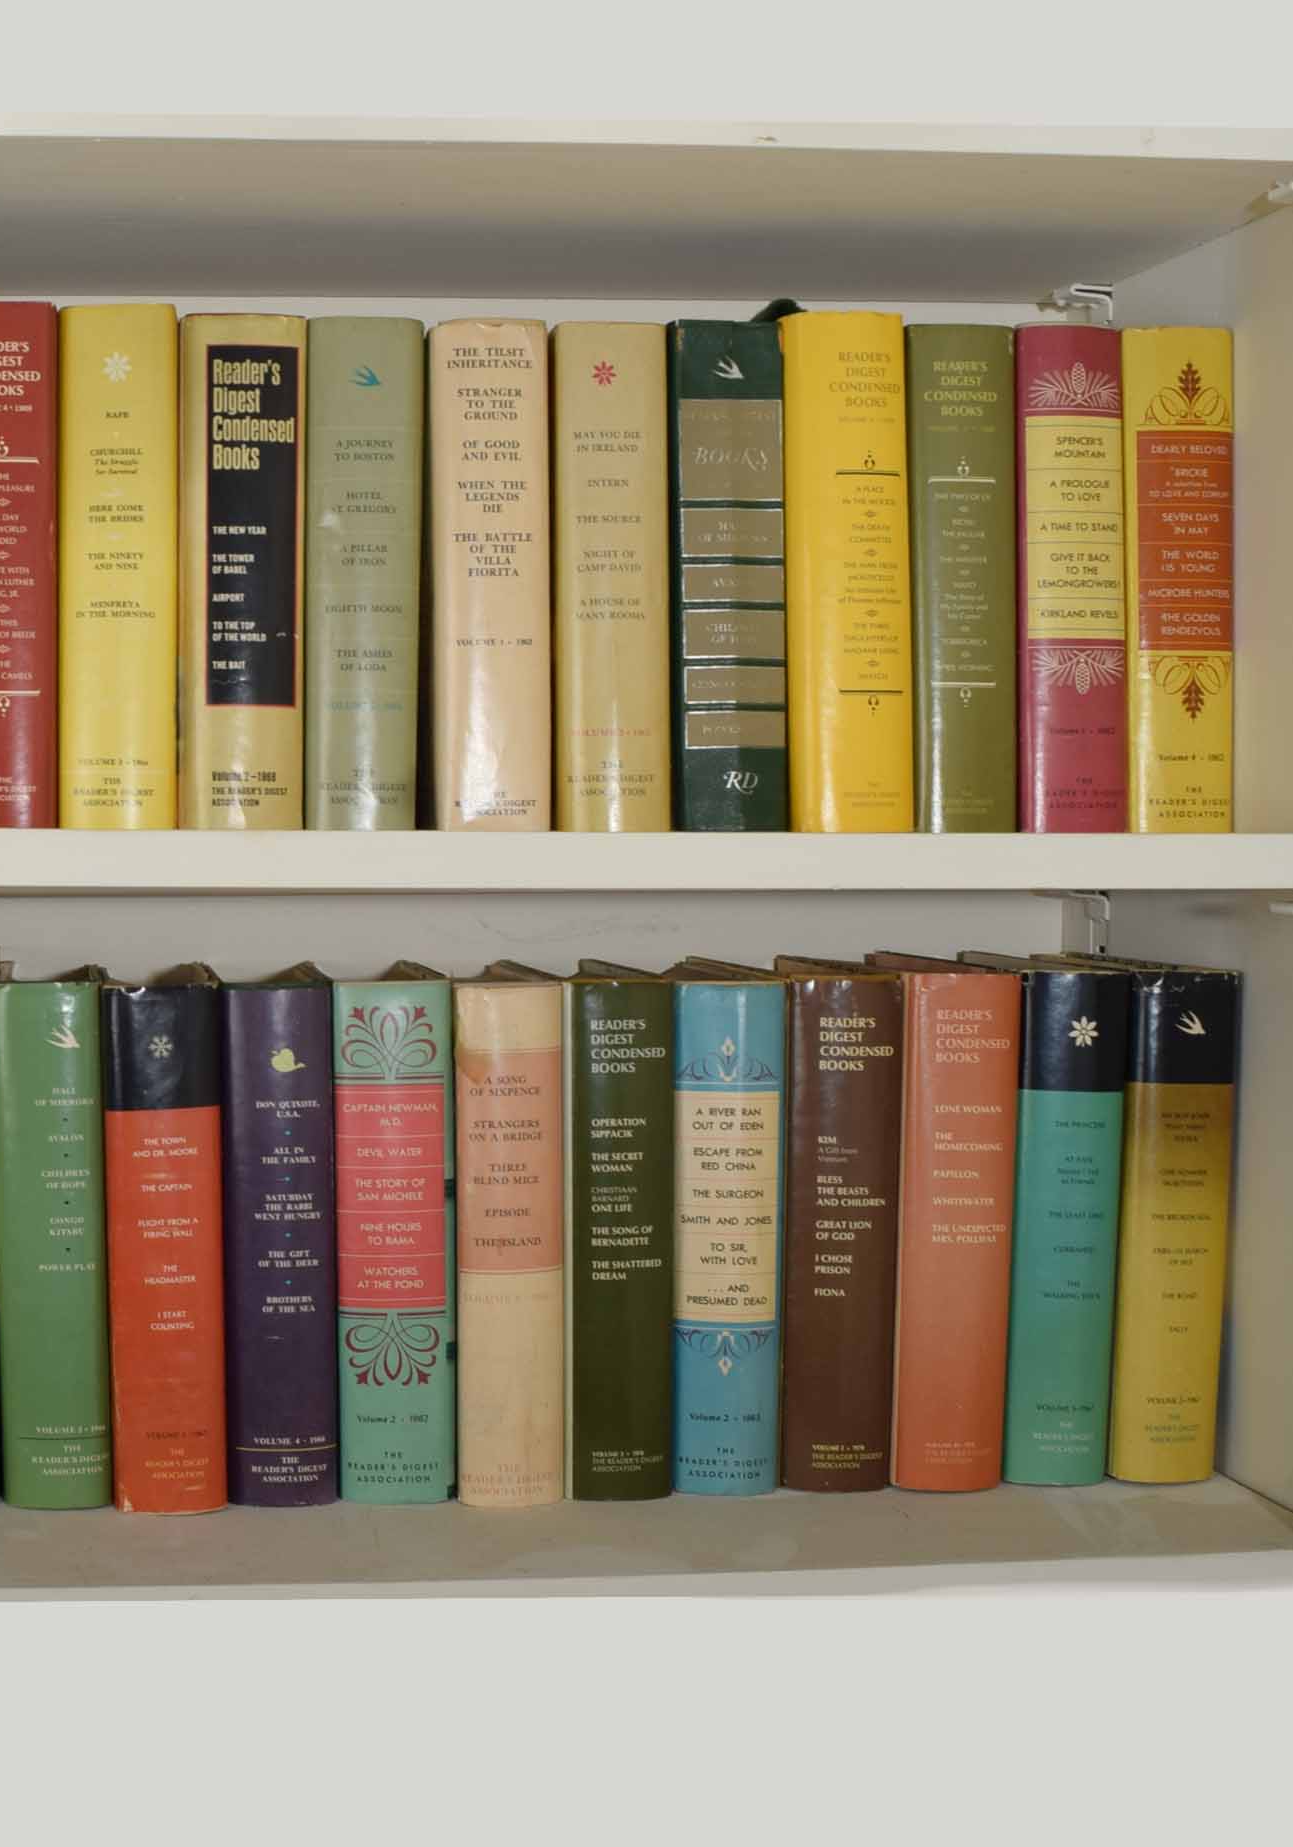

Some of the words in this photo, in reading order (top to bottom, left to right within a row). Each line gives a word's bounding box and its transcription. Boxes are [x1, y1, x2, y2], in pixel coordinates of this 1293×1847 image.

[453, 348, 479, 357] THE
[487, 348, 525, 357] TILSIT
[447, 360, 532, 370] INHERITANCE
[213, 359, 280, 385] Reader's
[941, 376, 982, 386] DIGEST
[458, 388, 522, 397] STRANGER
[213, 388, 260, 415] Digest
[467, 401, 484, 409] TO
[491, 400, 516, 408] THE
[465, 411, 517, 420] GROUND
[941, 406, 982, 416] BOOKS
[213, 415, 294, 443] Condensed
[463, 440, 479, 449] OF
[485, 440, 519, 448] GOOD
[213, 445, 259, 470] Books
[1055, 450, 1105, 459] MOUNTAIN
[1061, 480, 1109, 488] PROLOGUE
[1061, 493, 1075, 501] TO
[1079, 493, 1100, 502] LOVE
[483, 504, 503, 513] DIE
[1162, 513, 1193, 521] SEVEN
[1196, 513, 1219, 522] DAYS
[213, 527, 227, 535] THE
[229, 527, 244, 535] NEW
[246, 527, 266, 535] YEAR
[1051, 524, 1072, 532] TIME
[1076, 524, 1089, 532] TO
[1162, 551, 1179, 559] THE
[1186, 551, 1219, 559] WORLD
[476, 556, 511, 565] VILLA
[468, 568, 519, 577] FIORITA
[213, 593, 244, 602] AIRPORT
[1041, 610, 1086, 618] KIRKLAND
[1090, 610, 1118, 618] REVELS
[213, 633, 222, 642] OF
[224, 633, 238, 642] THE
[241, 633, 266, 642] WORLD
[591, 1019, 645, 1030] READER'S
[820, 1018, 875, 1028] READER'S
[937, 1024, 979, 1034] DIGEST
[591, 1034, 634, 1045] DIGEST
[820, 1032, 862, 1042] DIGEST
[936, 1039, 1010, 1049] CONDENSED
[591, 1048, 665, 1059] CONDENSED
[820, 1046, 893, 1057] CONDENSED
[936, 1053, 979, 1063] BOOKS
[591, 1063, 635, 1073] BOOKS
[819, 1061, 864, 1071] BOOKS
[343, 1104, 386, 1113] CAPTAIN
[709, 1108, 736, 1117] RIVER
[742, 1108, 761, 1116] RAN
[592, 1118, 646, 1127] OPERATION
[693, 1122, 713, 1130] OUT
[720, 1122, 733, 1130] OF
[740, 1121, 764, 1130] EDEN
[357, 1148, 383, 1157] DEVIL
[387, 1147, 423, 1157] WATER
[934, 1143, 1003, 1152] HOMECOMING
[592, 1165, 632, 1173] WOMAN
[933, 1170, 978, 1179] PAPILLON
[160, 1183, 192, 1192] CAPTAIN
[693, 1190, 711, 1198] THE
[716, 1190, 763, 1199] SURGEON
[255, 1213, 281, 1221] WENT
[485, 1209, 530, 1217] EPISODE
[700, 1257, 726, 1265] WITH
[732, 1257, 756, 1265] LOVE
[365, 1267, 418, 1276] WATCHERS
[815, 1266, 851, 1275] PRISON
[592, 1273, 626, 1281] DREAM
[814, 1288, 845, 1297] FIONA
